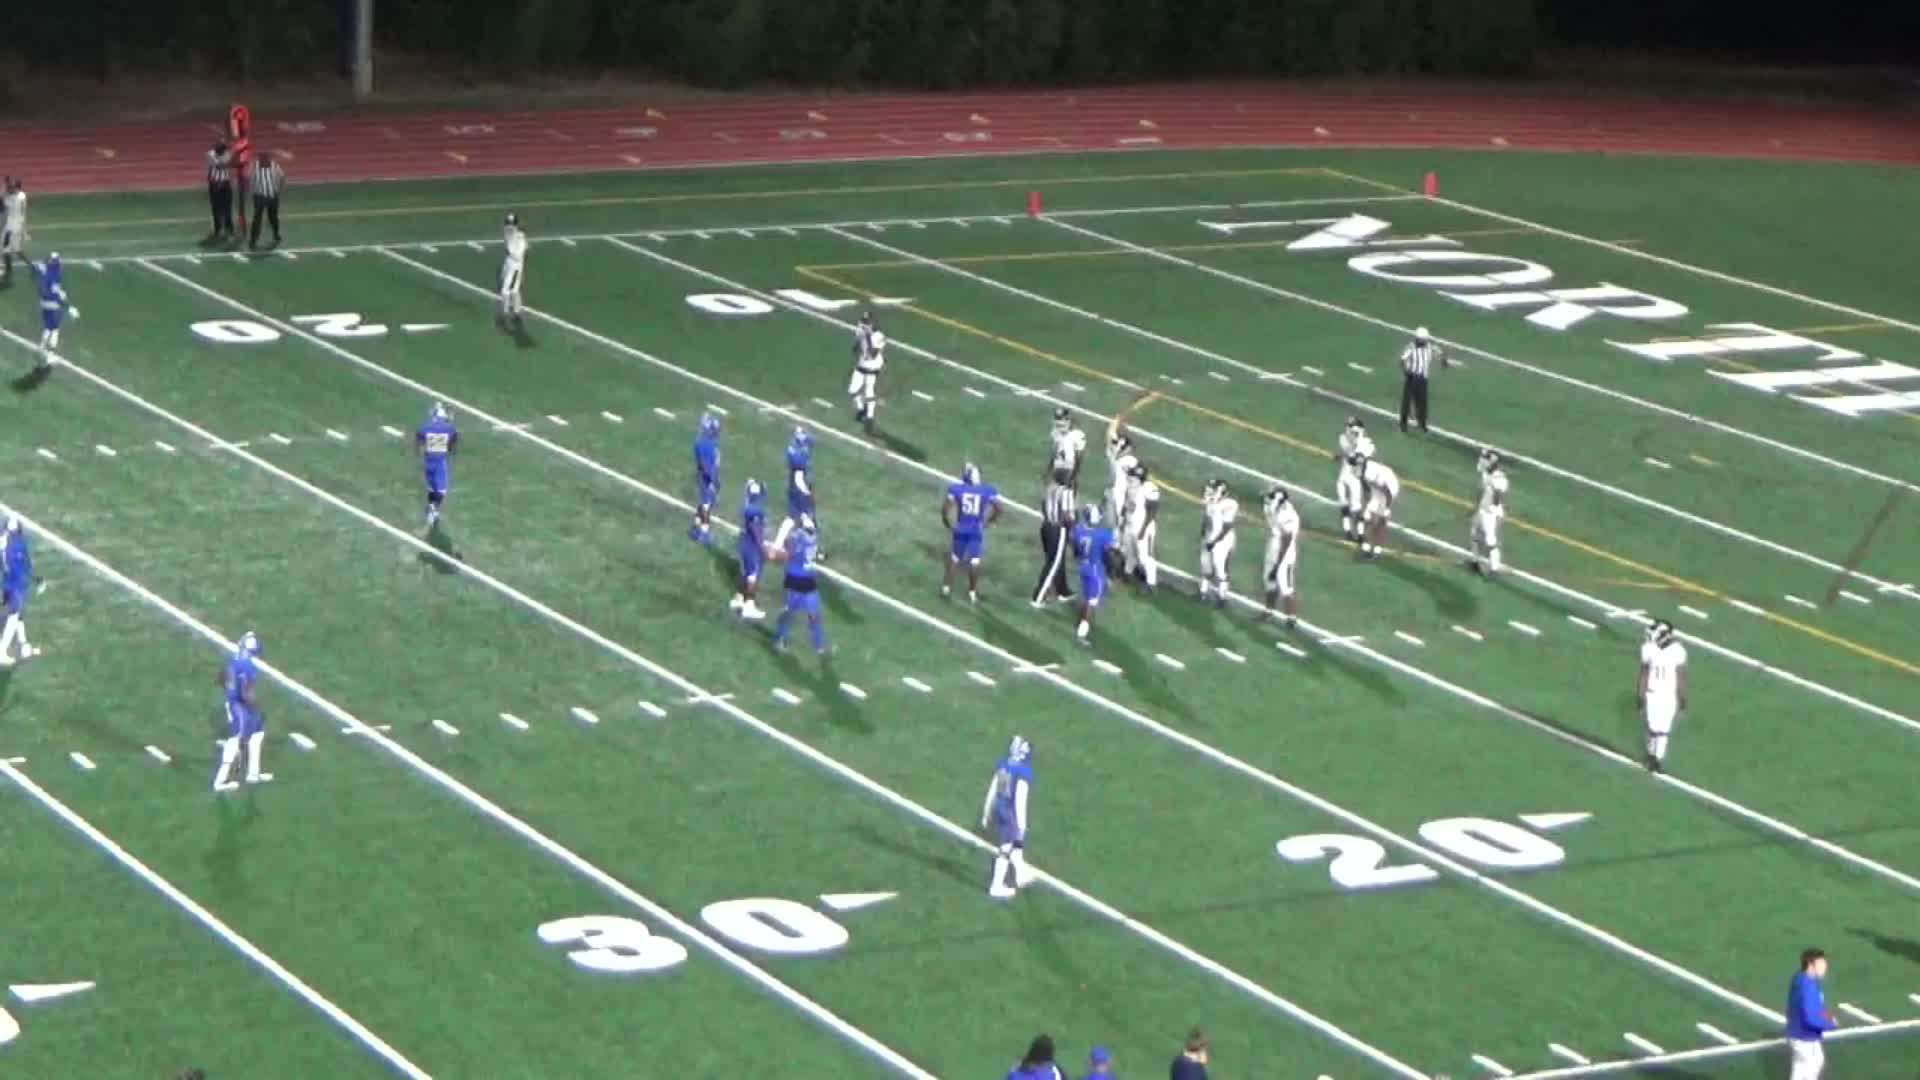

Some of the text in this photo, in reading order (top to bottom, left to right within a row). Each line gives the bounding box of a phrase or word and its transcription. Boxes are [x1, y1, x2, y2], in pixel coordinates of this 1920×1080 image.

[1198, 213, 1920, 417] NORTH
[961, 493, 981, 515] 51
[1276, 816, 1566, 888] 20
[537, 897, 850, 972] 30
